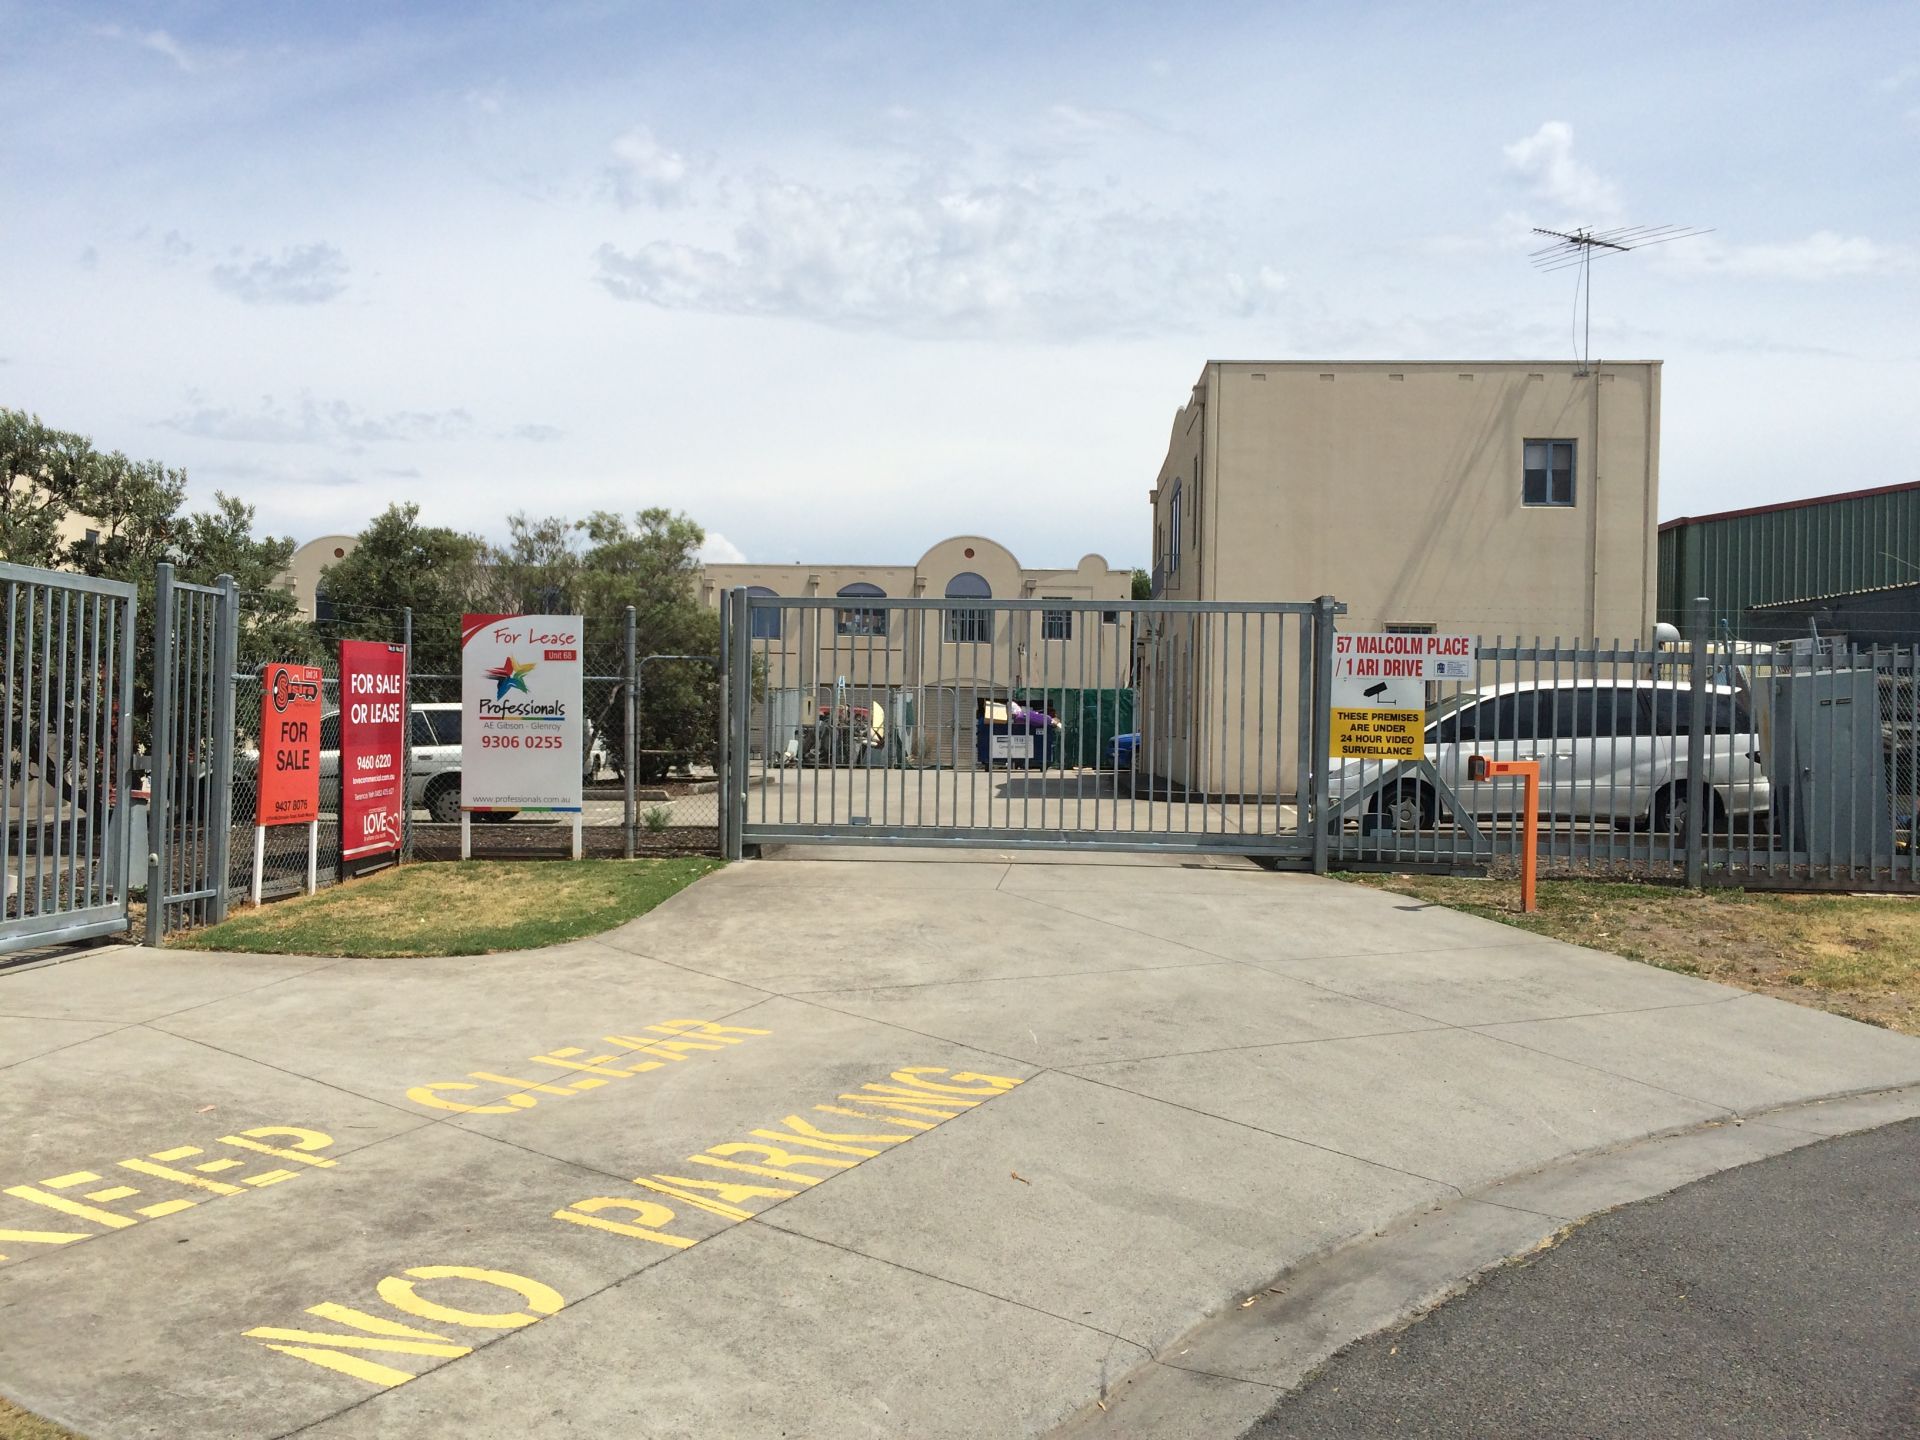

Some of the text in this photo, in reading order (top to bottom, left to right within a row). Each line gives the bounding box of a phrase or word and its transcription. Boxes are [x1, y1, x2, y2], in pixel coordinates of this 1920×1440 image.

[494, 627, 576, 645] For Lease
[1337, 636, 1469, 656] 57 MALCOLM PLACE
[548, 651, 561, 660] Unit
[1346, 658, 1352, 675] 1
[1356, 658, 1379, 676] ARI
[1383, 659, 1423, 677] DRIVE
[351, 673, 400, 694] FOR SALE
[351, 703, 400, 724] OR LEASE
[479, 698, 565, 720] Professionals
[1337, 712, 1419, 722] THESE PREMISES
[281, 721, 308, 743] FOR
[496, 721, 524, 730] Gibson
[531, 722, 562, 732] Glenroy
[1350, 724, 1406, 733] ARE UNDER
[482, 735, 562, 749] 9306 0255
[1355, 735, 1382, 743] HOUR
[1385, 736, 1415, 744] VIDEO
[1342, 746, 1413, 755] SURVEILLANCE
[276, 749, 310, 771] SALE
[357, 753, 392, 770] 9460 6220
[472, 795, 571, 804] www.professionals.com.au
[363, 811, 387, 835] LOVE
[406, 1019, 773, 1114] CLEAR
[240, 1066, 1025, 1388] NO PARKING
